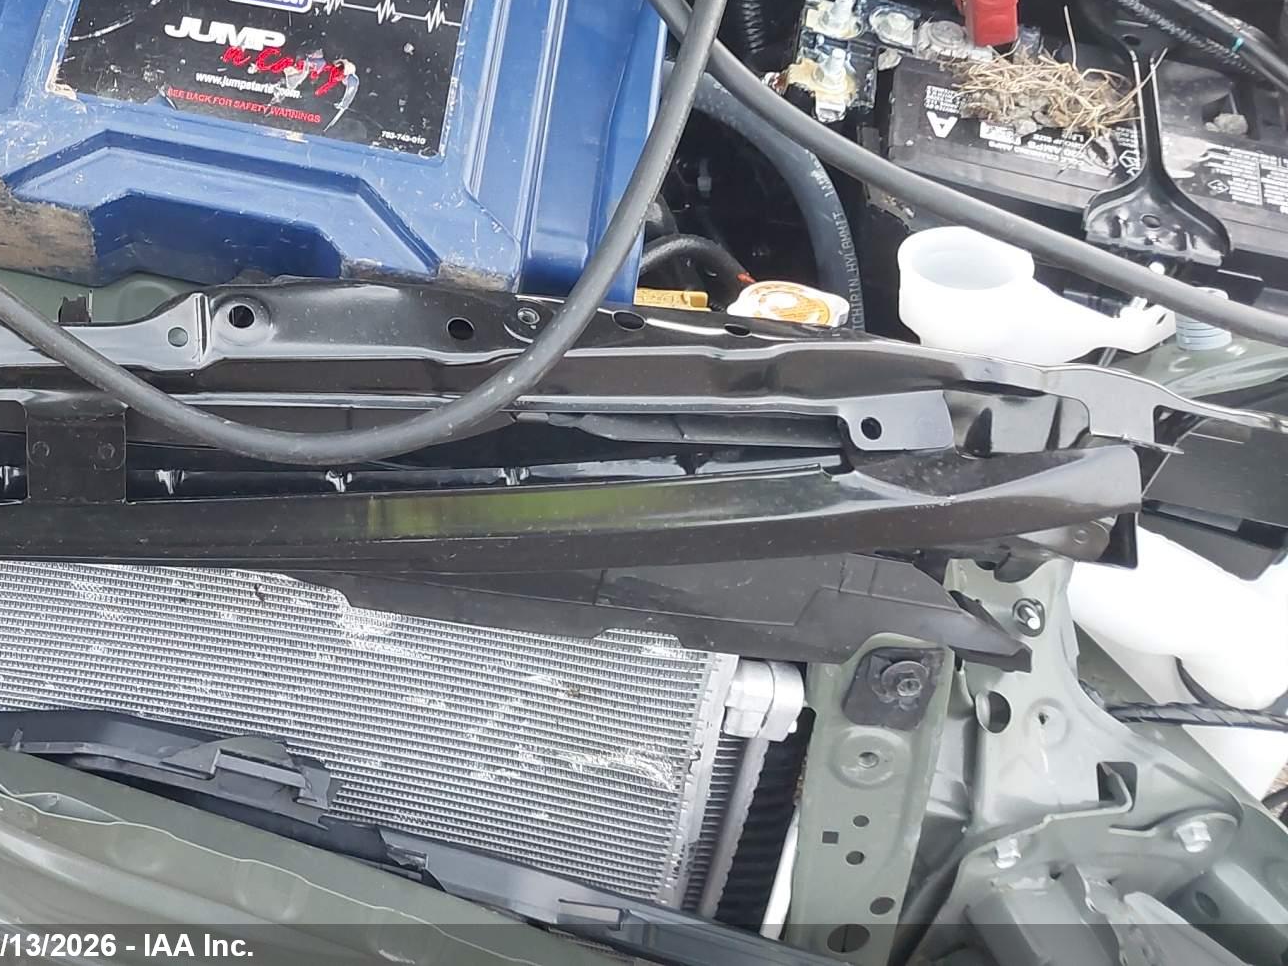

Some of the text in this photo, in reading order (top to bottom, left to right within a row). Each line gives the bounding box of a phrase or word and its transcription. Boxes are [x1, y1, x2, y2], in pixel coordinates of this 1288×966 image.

[164, 16, 286, 51] JUMP
[166, 86, 321, 124] SEE BACK FOR SAFETY WARNINGS
[848, 278, 866, 331] ICHIRIN
